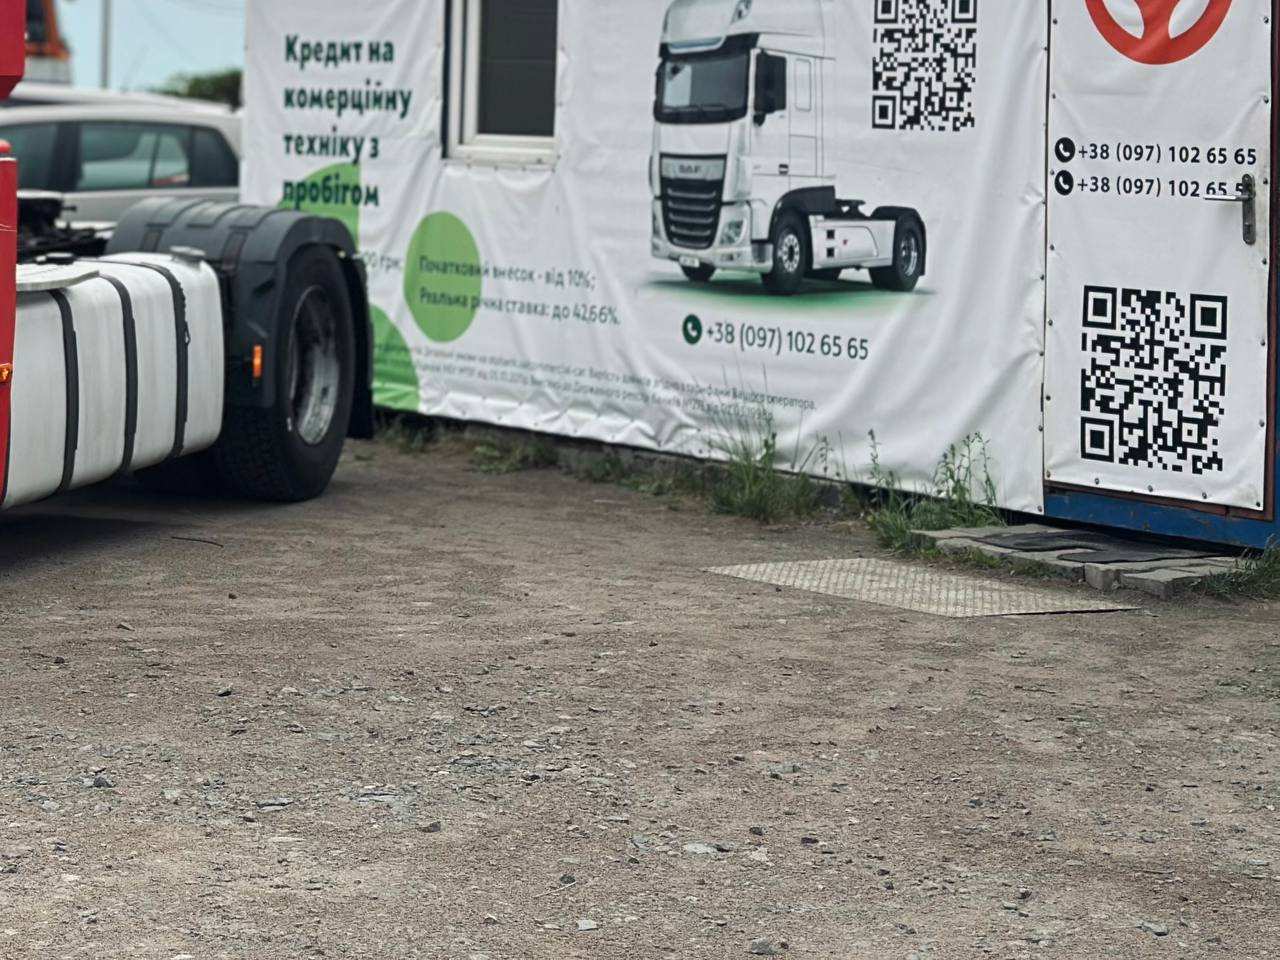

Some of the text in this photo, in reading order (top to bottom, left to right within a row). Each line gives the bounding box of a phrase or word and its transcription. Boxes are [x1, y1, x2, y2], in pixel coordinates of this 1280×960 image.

[285, 34, 395, 70] Кредит на
[284, 77, 412, 119] комерційну
[283, 125, 379, 166] техніку з
[1078, 142, 1256, 165] +38 (097) 102 65 65
[283, 172, 379, 210] пробігом
[1077, 176, 1110, 193] +38
[1116, 175, 1161, 197] (097)
[1169, 180, 1200, 197] 102
[493, 265, 535, 283] внесок
[545, 267, 565, 288] від
[471, 296, 503, 312] рчна
[552, 305, 570, 321] до
[707, 322, 869, 360] +38 (097) 102 65 65
